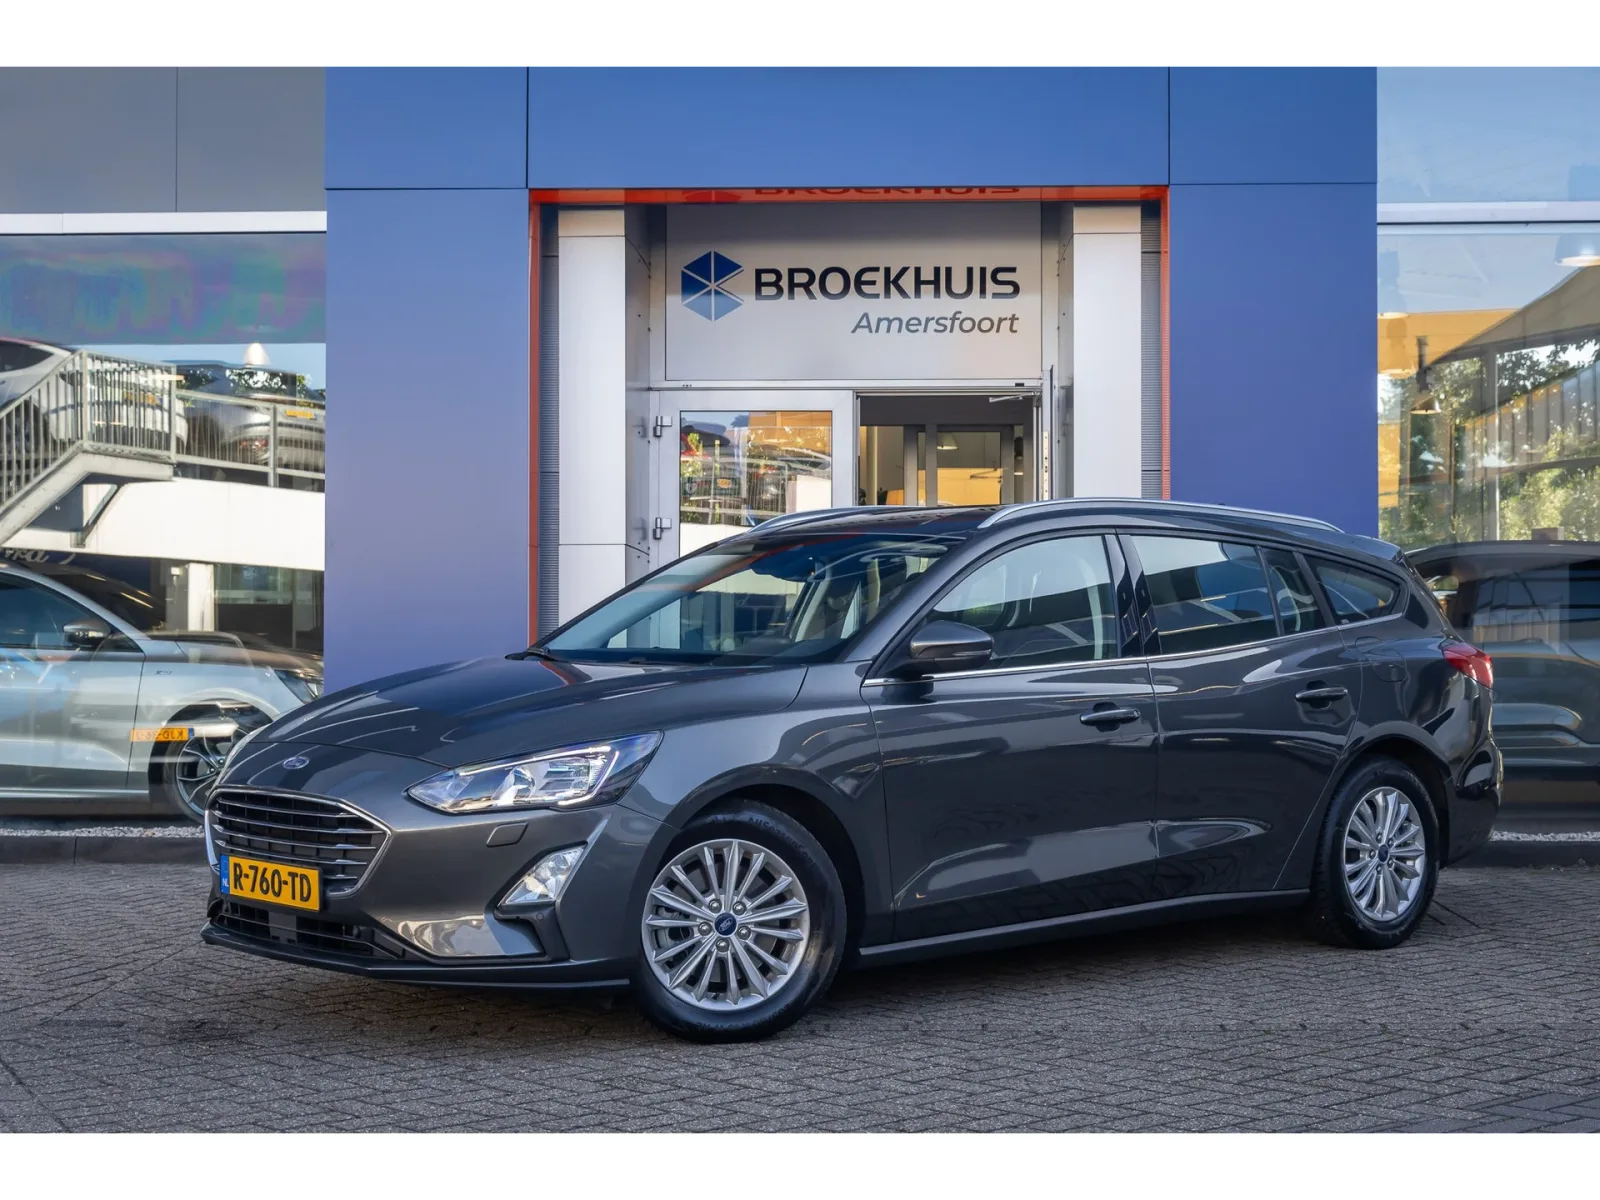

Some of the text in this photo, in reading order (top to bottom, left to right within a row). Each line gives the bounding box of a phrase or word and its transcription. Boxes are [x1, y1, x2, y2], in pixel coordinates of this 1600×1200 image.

[754, 266, 1021, 301] BROEKHUIS
[851, 311, 1019, 334] Amersfoort
[233, 862, 312, 902] R-760-TD
